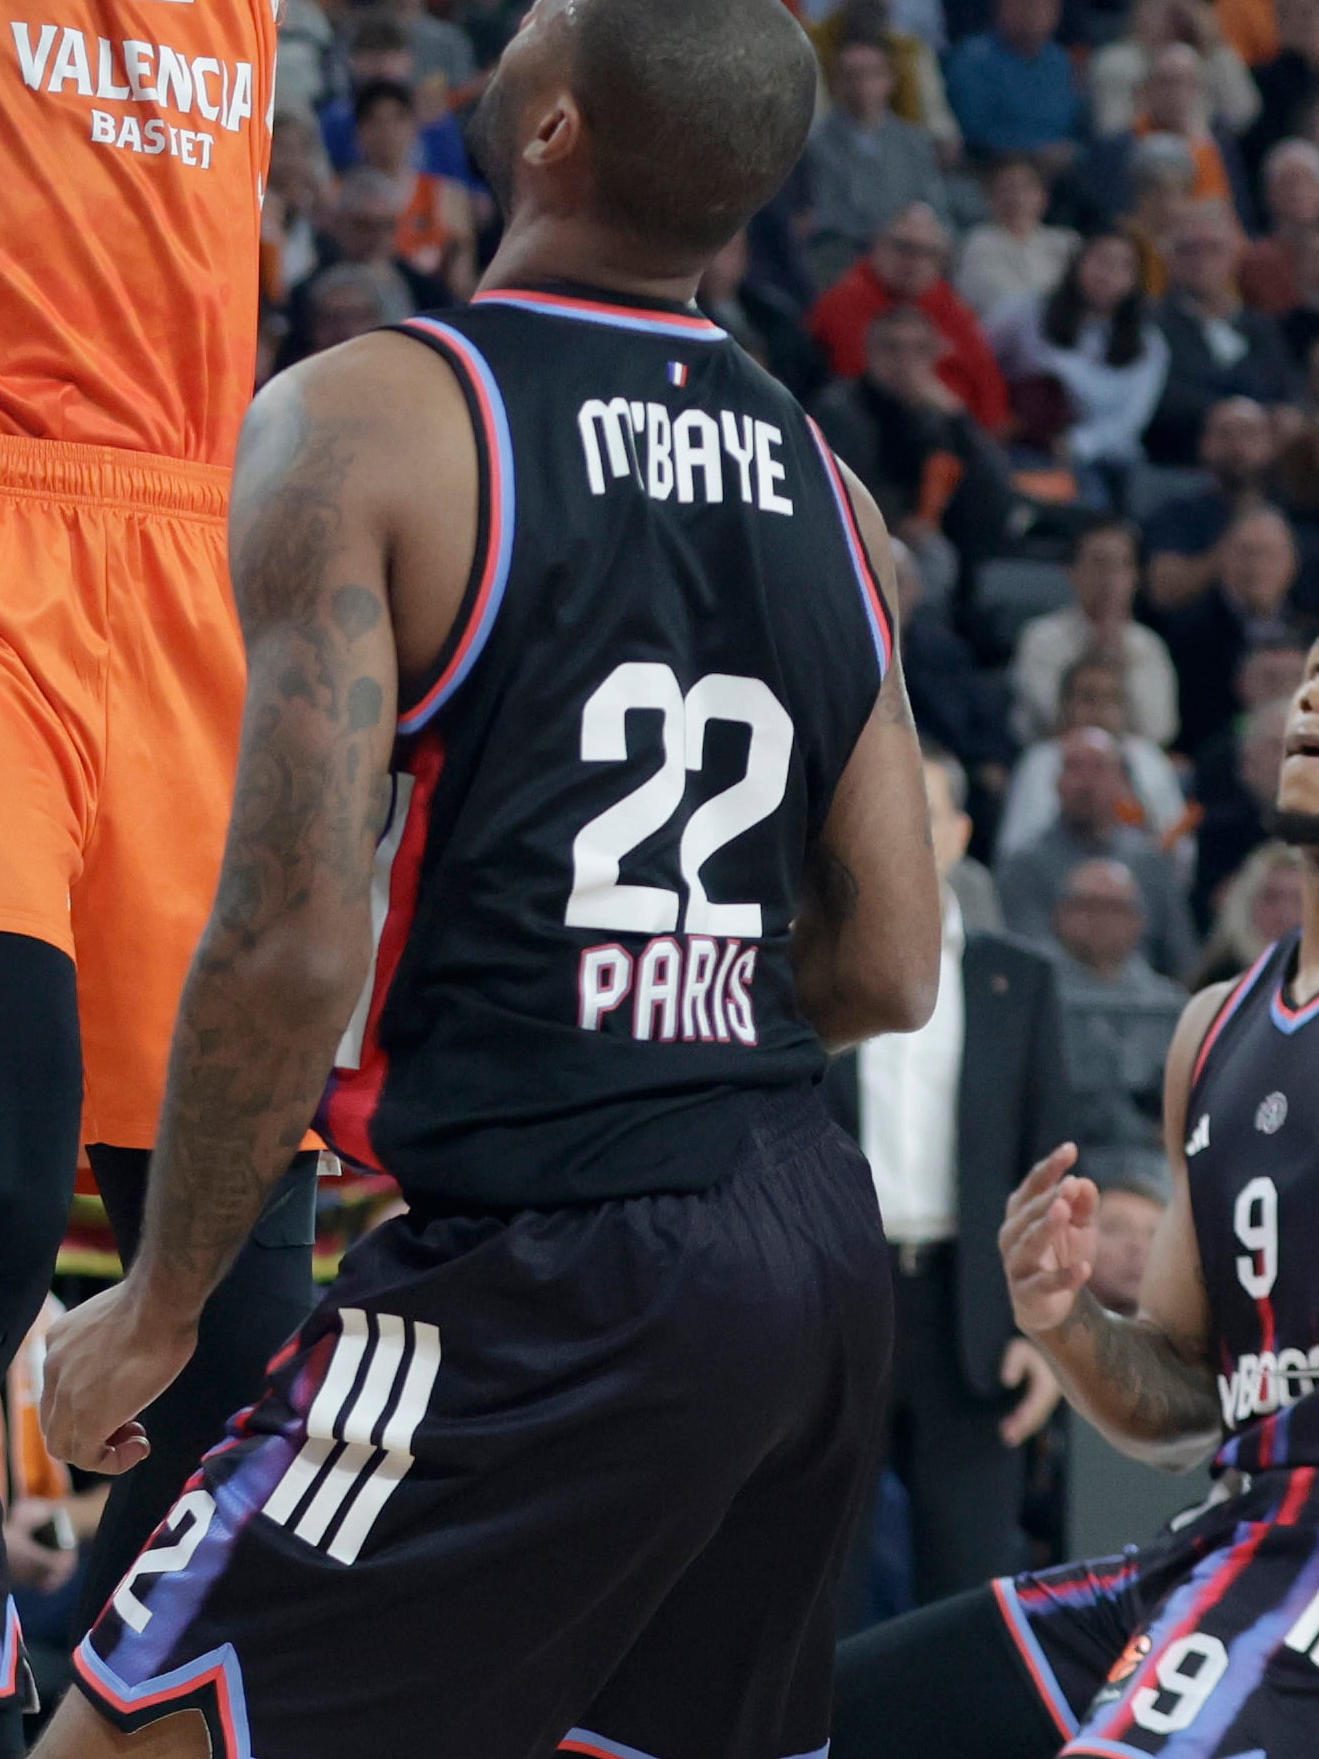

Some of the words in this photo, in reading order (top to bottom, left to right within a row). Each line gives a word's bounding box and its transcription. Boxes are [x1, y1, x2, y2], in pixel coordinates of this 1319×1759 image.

[577, 397, 794, 517] M'BAYE
[564, 661, 795, 939] 22
[578, 934, 760, 1047] PARIS
[1233, 1176, 1279, 1300] 9
[113, 1489, 217, 1634] 2
[1131, 1632, 1229, 1734] 9
